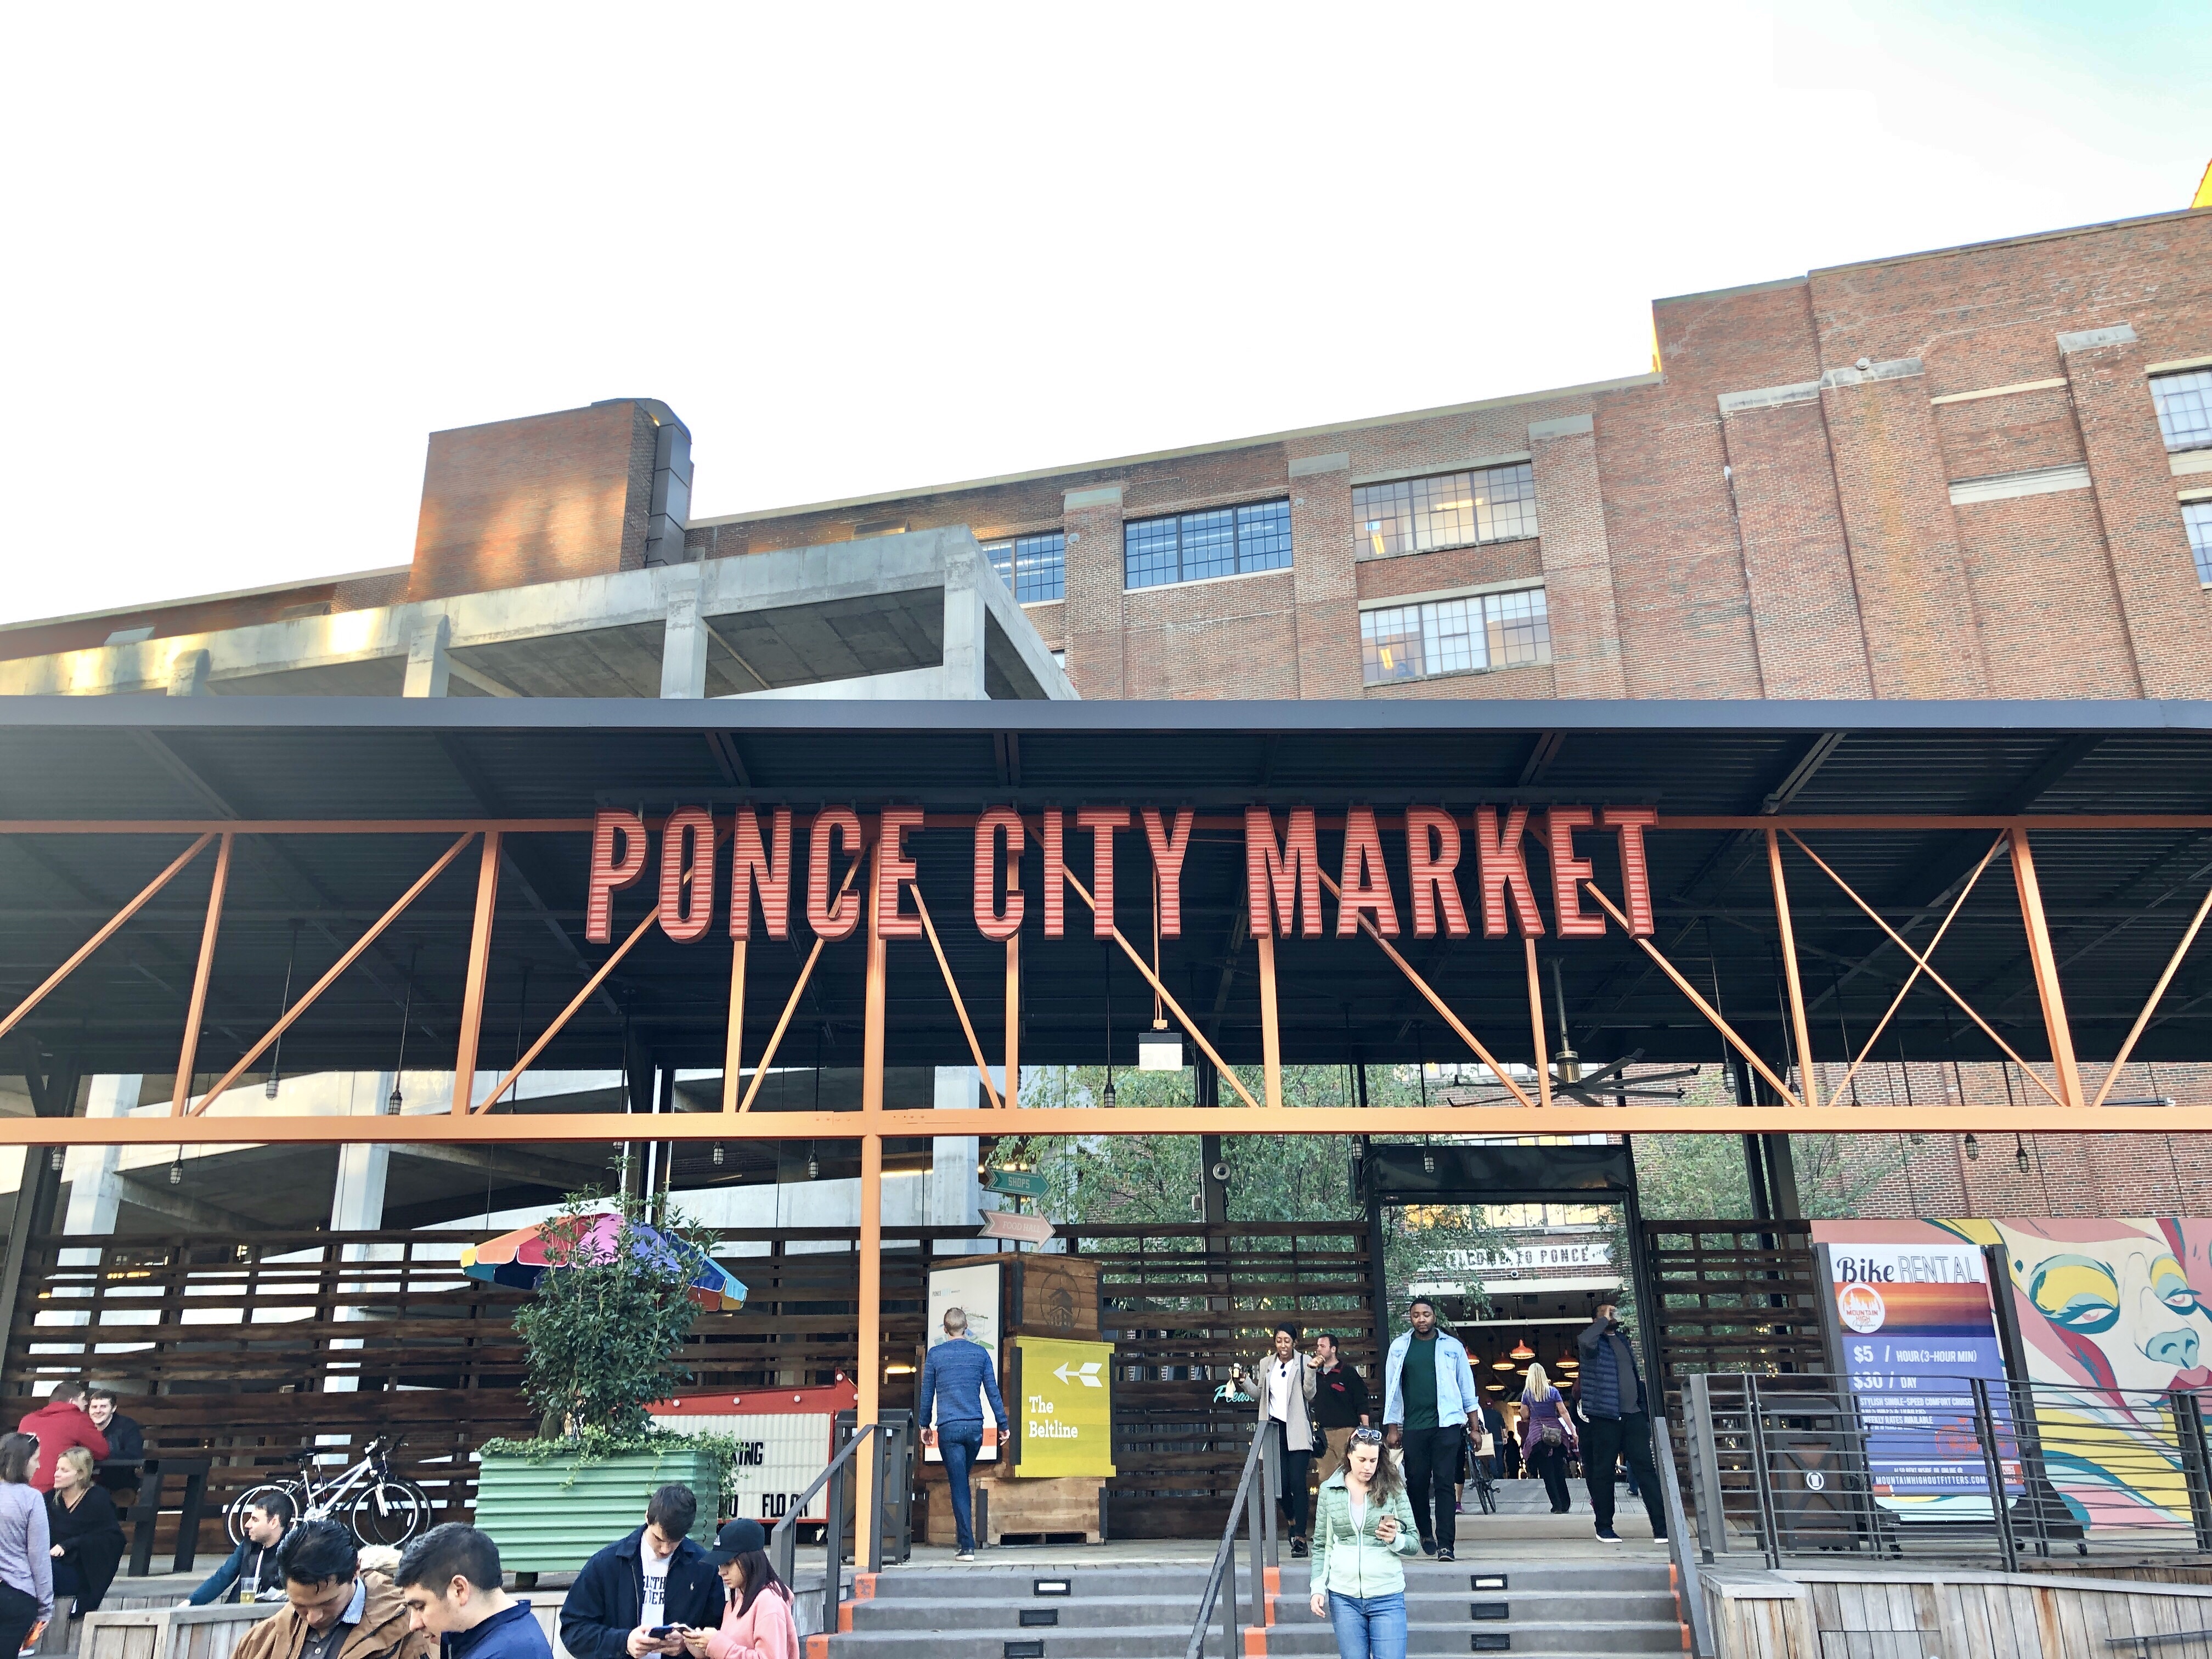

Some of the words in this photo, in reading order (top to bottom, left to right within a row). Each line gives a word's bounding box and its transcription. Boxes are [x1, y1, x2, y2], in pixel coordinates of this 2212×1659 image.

[585, 805, 924, 944] PONCE
[973, 805, 1194, 941] CITY
[1244, 805, 1658, 940] MARKET
[1008, 1176, 1030, 1189] SHOPS
[1003, 1221, 1022, 1230] FOOD
[1023, 1223, 1041, 1233] HALL
[1541, 1248, 1589, 1263] PONCE
[1837, 1257, 1894, 1282] Bike
[1898, 1256, 1979, 1283] RENTAL
[1853, 1345, 1874, 1364] $5
[1884, 1345, 1890, 1362] /
[1957, 1350, 1977, 1363] MIN)
[1853, 1371, 1883, 1390] $30
[1900, 1377, 1917, 1389] DAY
[1214, 1384, 1255, 1403] Peas
[1860, 1397, 1883, 1406] STYLISH
[1884, 1397, 1925, 1406] SINGLE-SPEED
[1925, 1397, 1951, 1406] COMFORT
[1029, 1395, 1054, 1413] The
[1029, 1419, 1078, 1438] Beltline
[1863, 1415, 1884, 1424] WEEKLY
[1885, 1415, 1903, 1424] RATES
[1904, 1415, 1933, 1424] AVAILABLE
[732, 1442, 763, 1465] ING
[1876, 1476, 1987, 1485] MOUNTAINHIGHOUTFITTERS.COM
